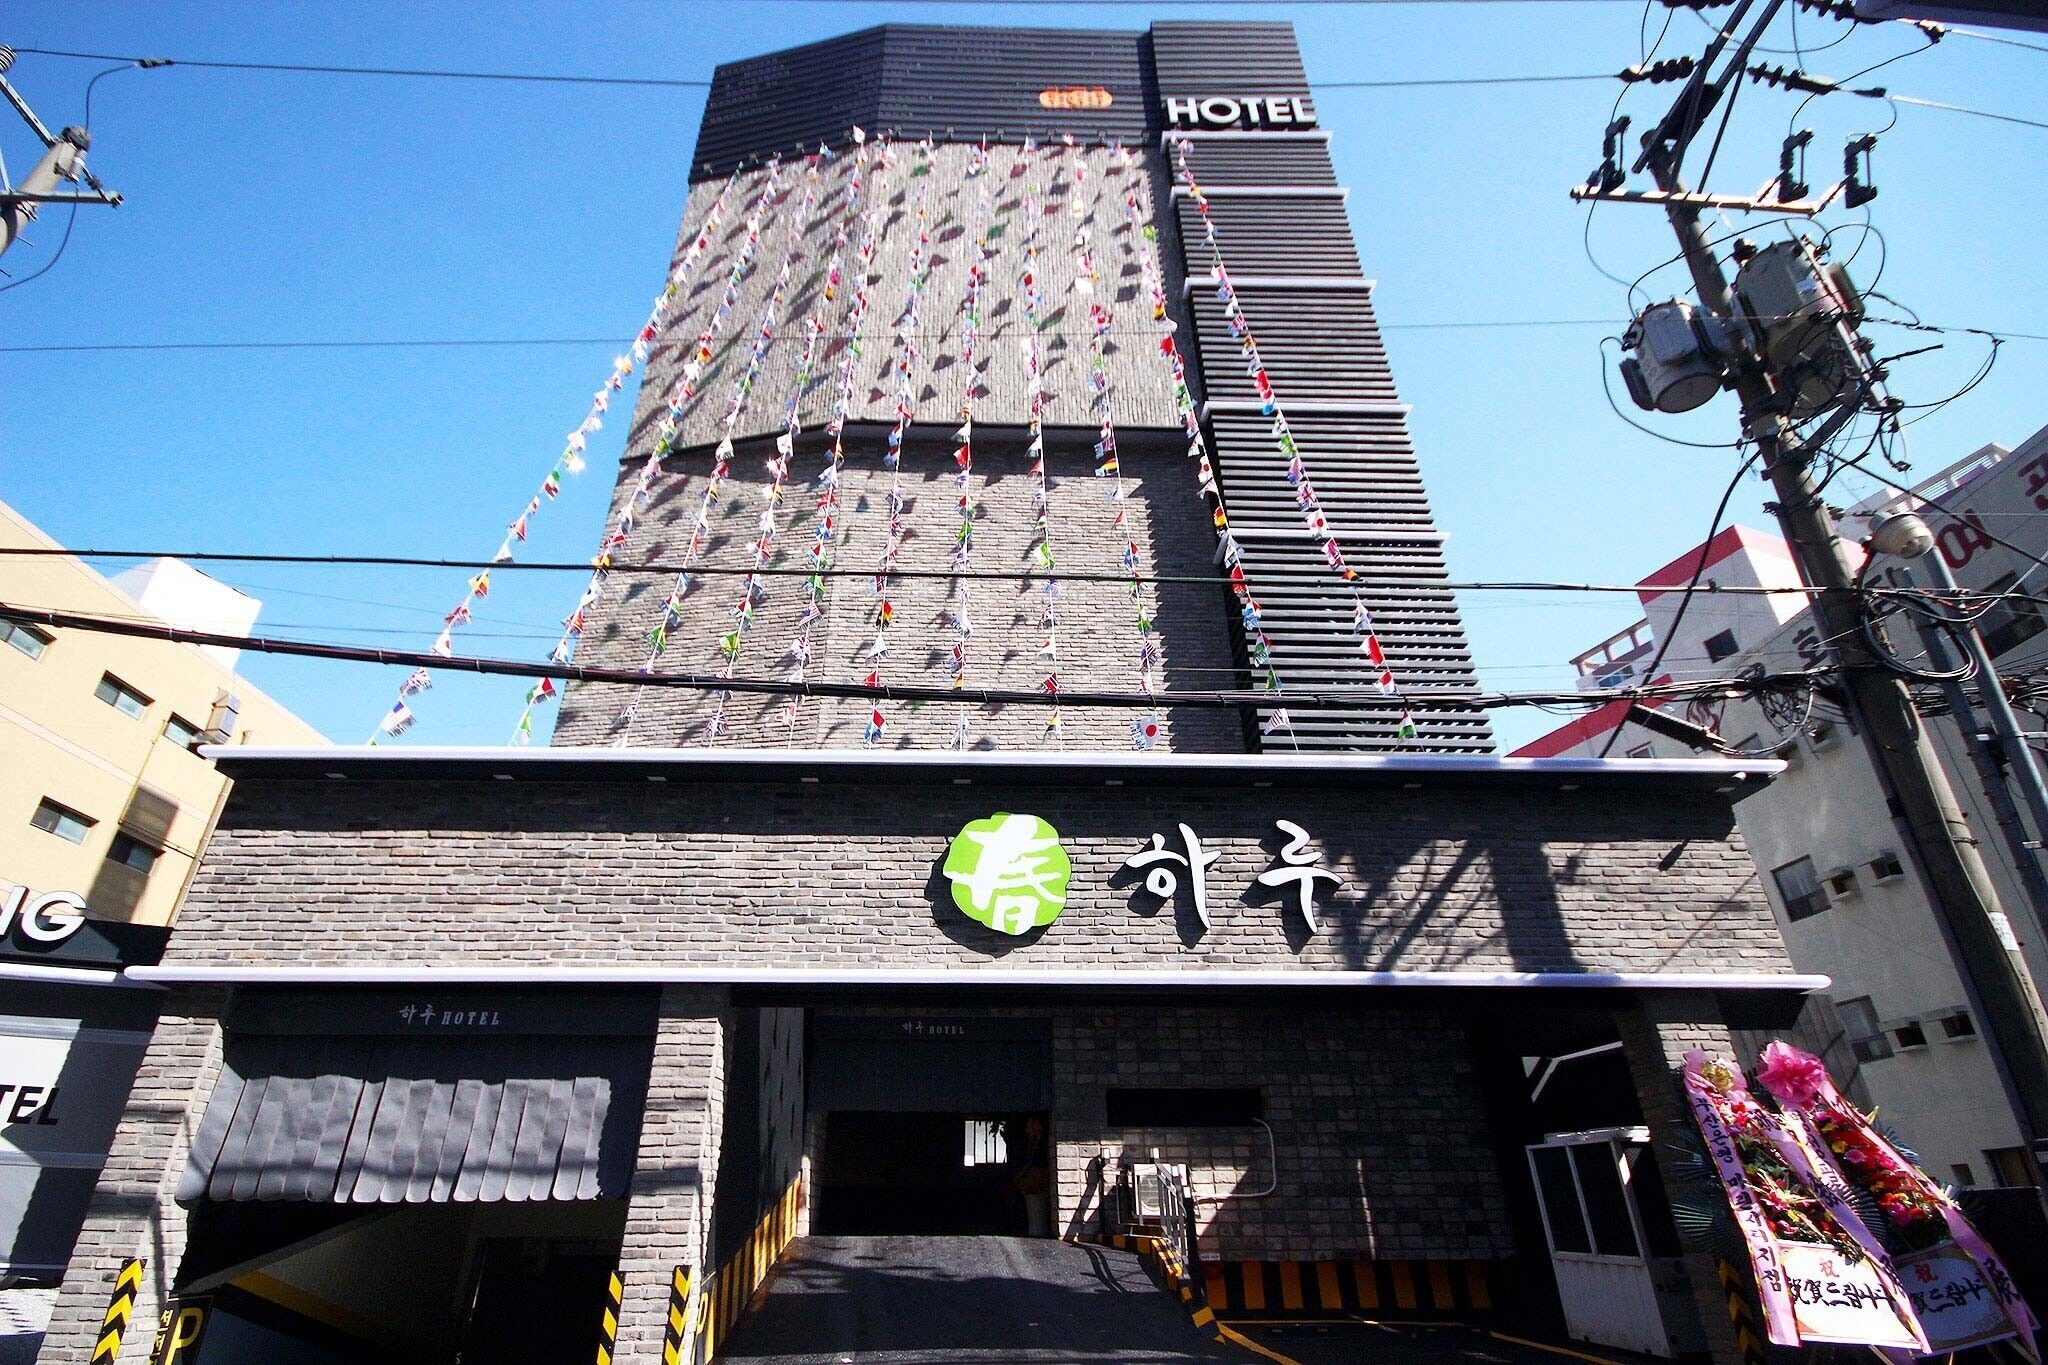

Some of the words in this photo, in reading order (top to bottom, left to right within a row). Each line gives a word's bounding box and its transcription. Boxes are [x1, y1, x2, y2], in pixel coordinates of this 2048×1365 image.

[1166, 97, 1318, 124] HOTEL
[1126, 819, 1345, 934] 하루
[399, 1003, 436, 1026] 하루
[441, 1011, 500, 1025] HOTEL
[928, 1025, 965, 1034] HOTEL
[163, 1306, 204, 1365] P
